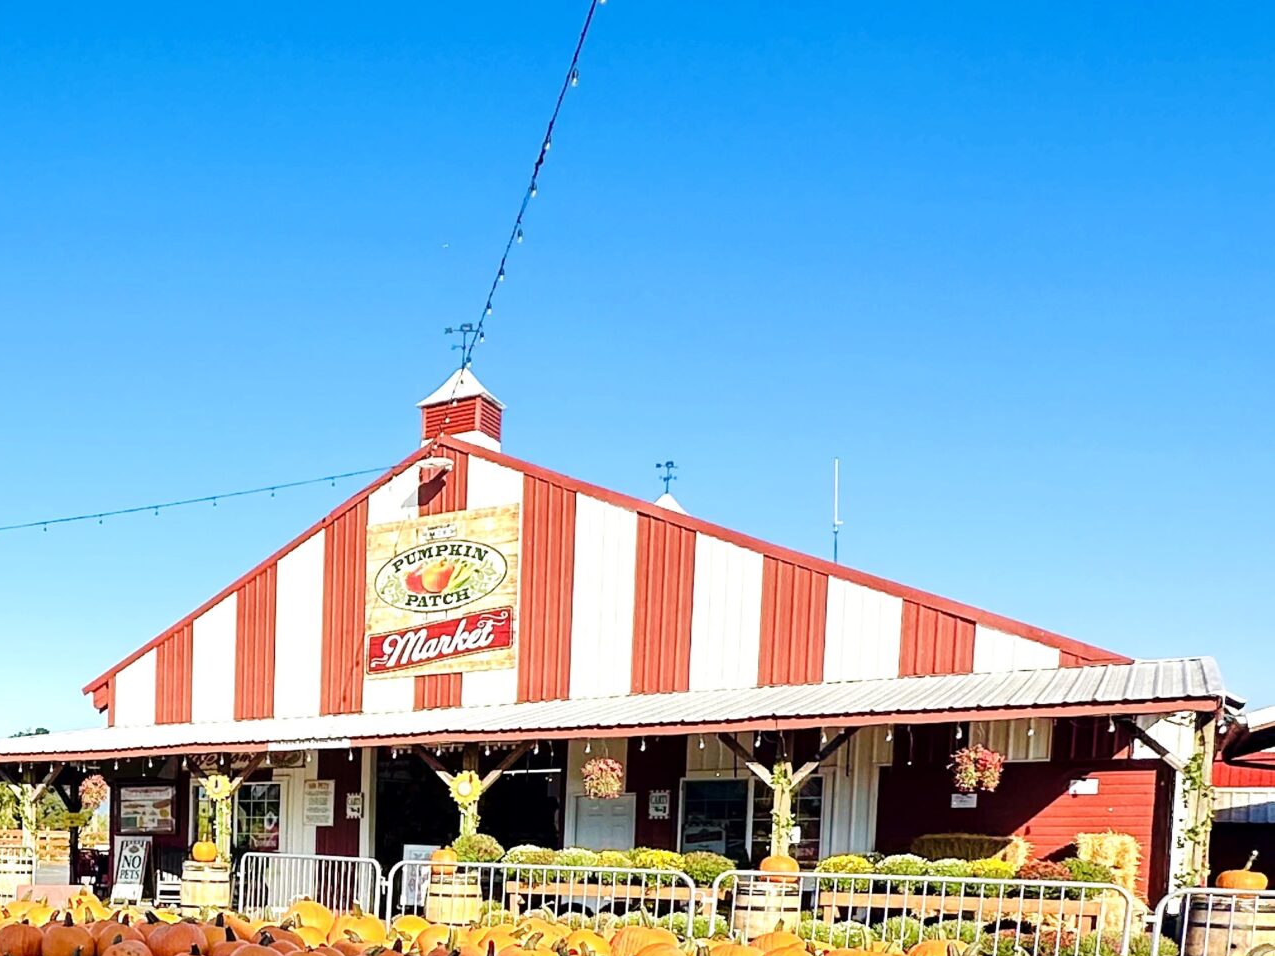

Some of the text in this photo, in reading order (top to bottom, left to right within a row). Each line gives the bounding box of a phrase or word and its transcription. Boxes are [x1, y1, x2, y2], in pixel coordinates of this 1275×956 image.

[391, 544, 488, 573] PUMPKIN
[405, 587, 470, 607] PATCH
[373, 612, 505, 667] Market
[121, 855, 141, 869] NO
[120, 870, 140, 880] PETS
